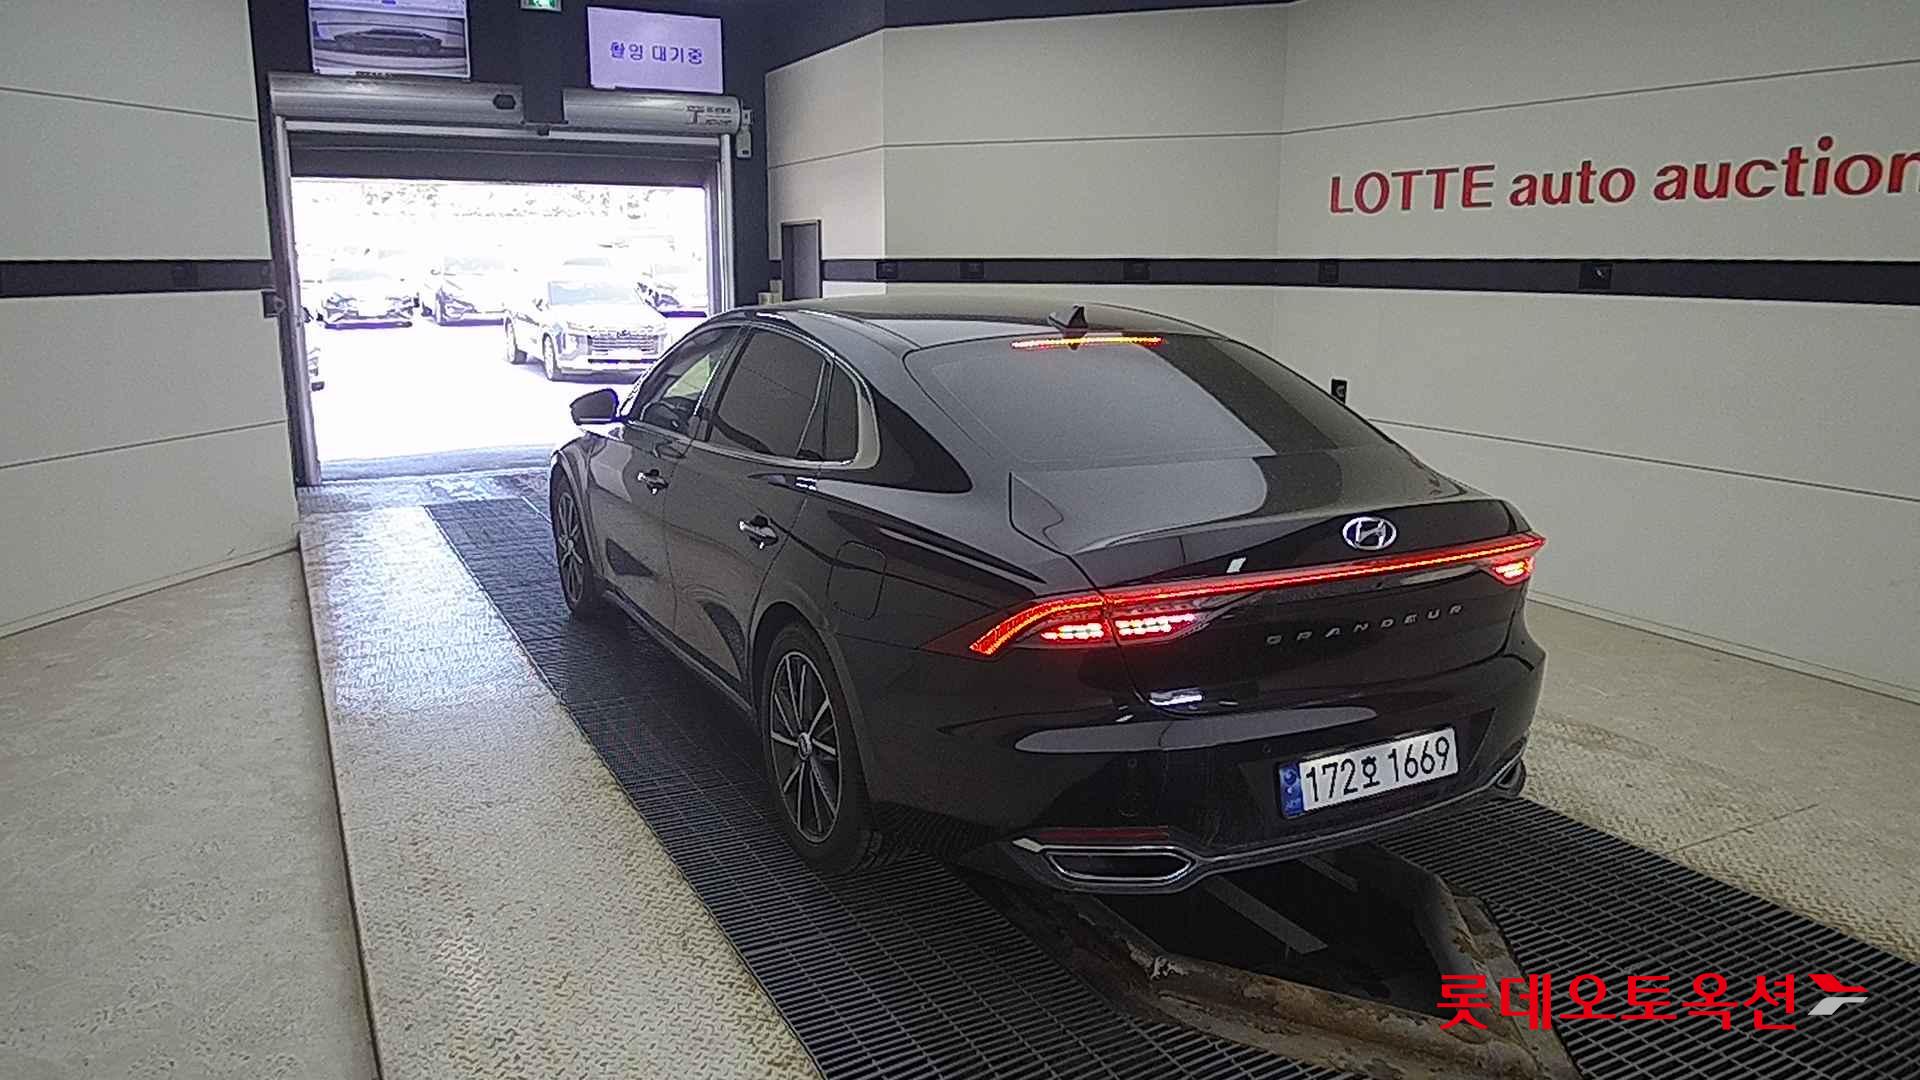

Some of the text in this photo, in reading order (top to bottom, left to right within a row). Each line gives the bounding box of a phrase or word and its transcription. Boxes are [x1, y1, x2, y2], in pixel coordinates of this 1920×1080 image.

[651, 45, 703, 65] 대기중
[1330, 164, 1496, 214] LOTTE
[1510, 160, 1637, 206] auto
[1266, 604, 1463, 645] GRANDEUR
[1305, 736, 1450, 802] 172호 1669
